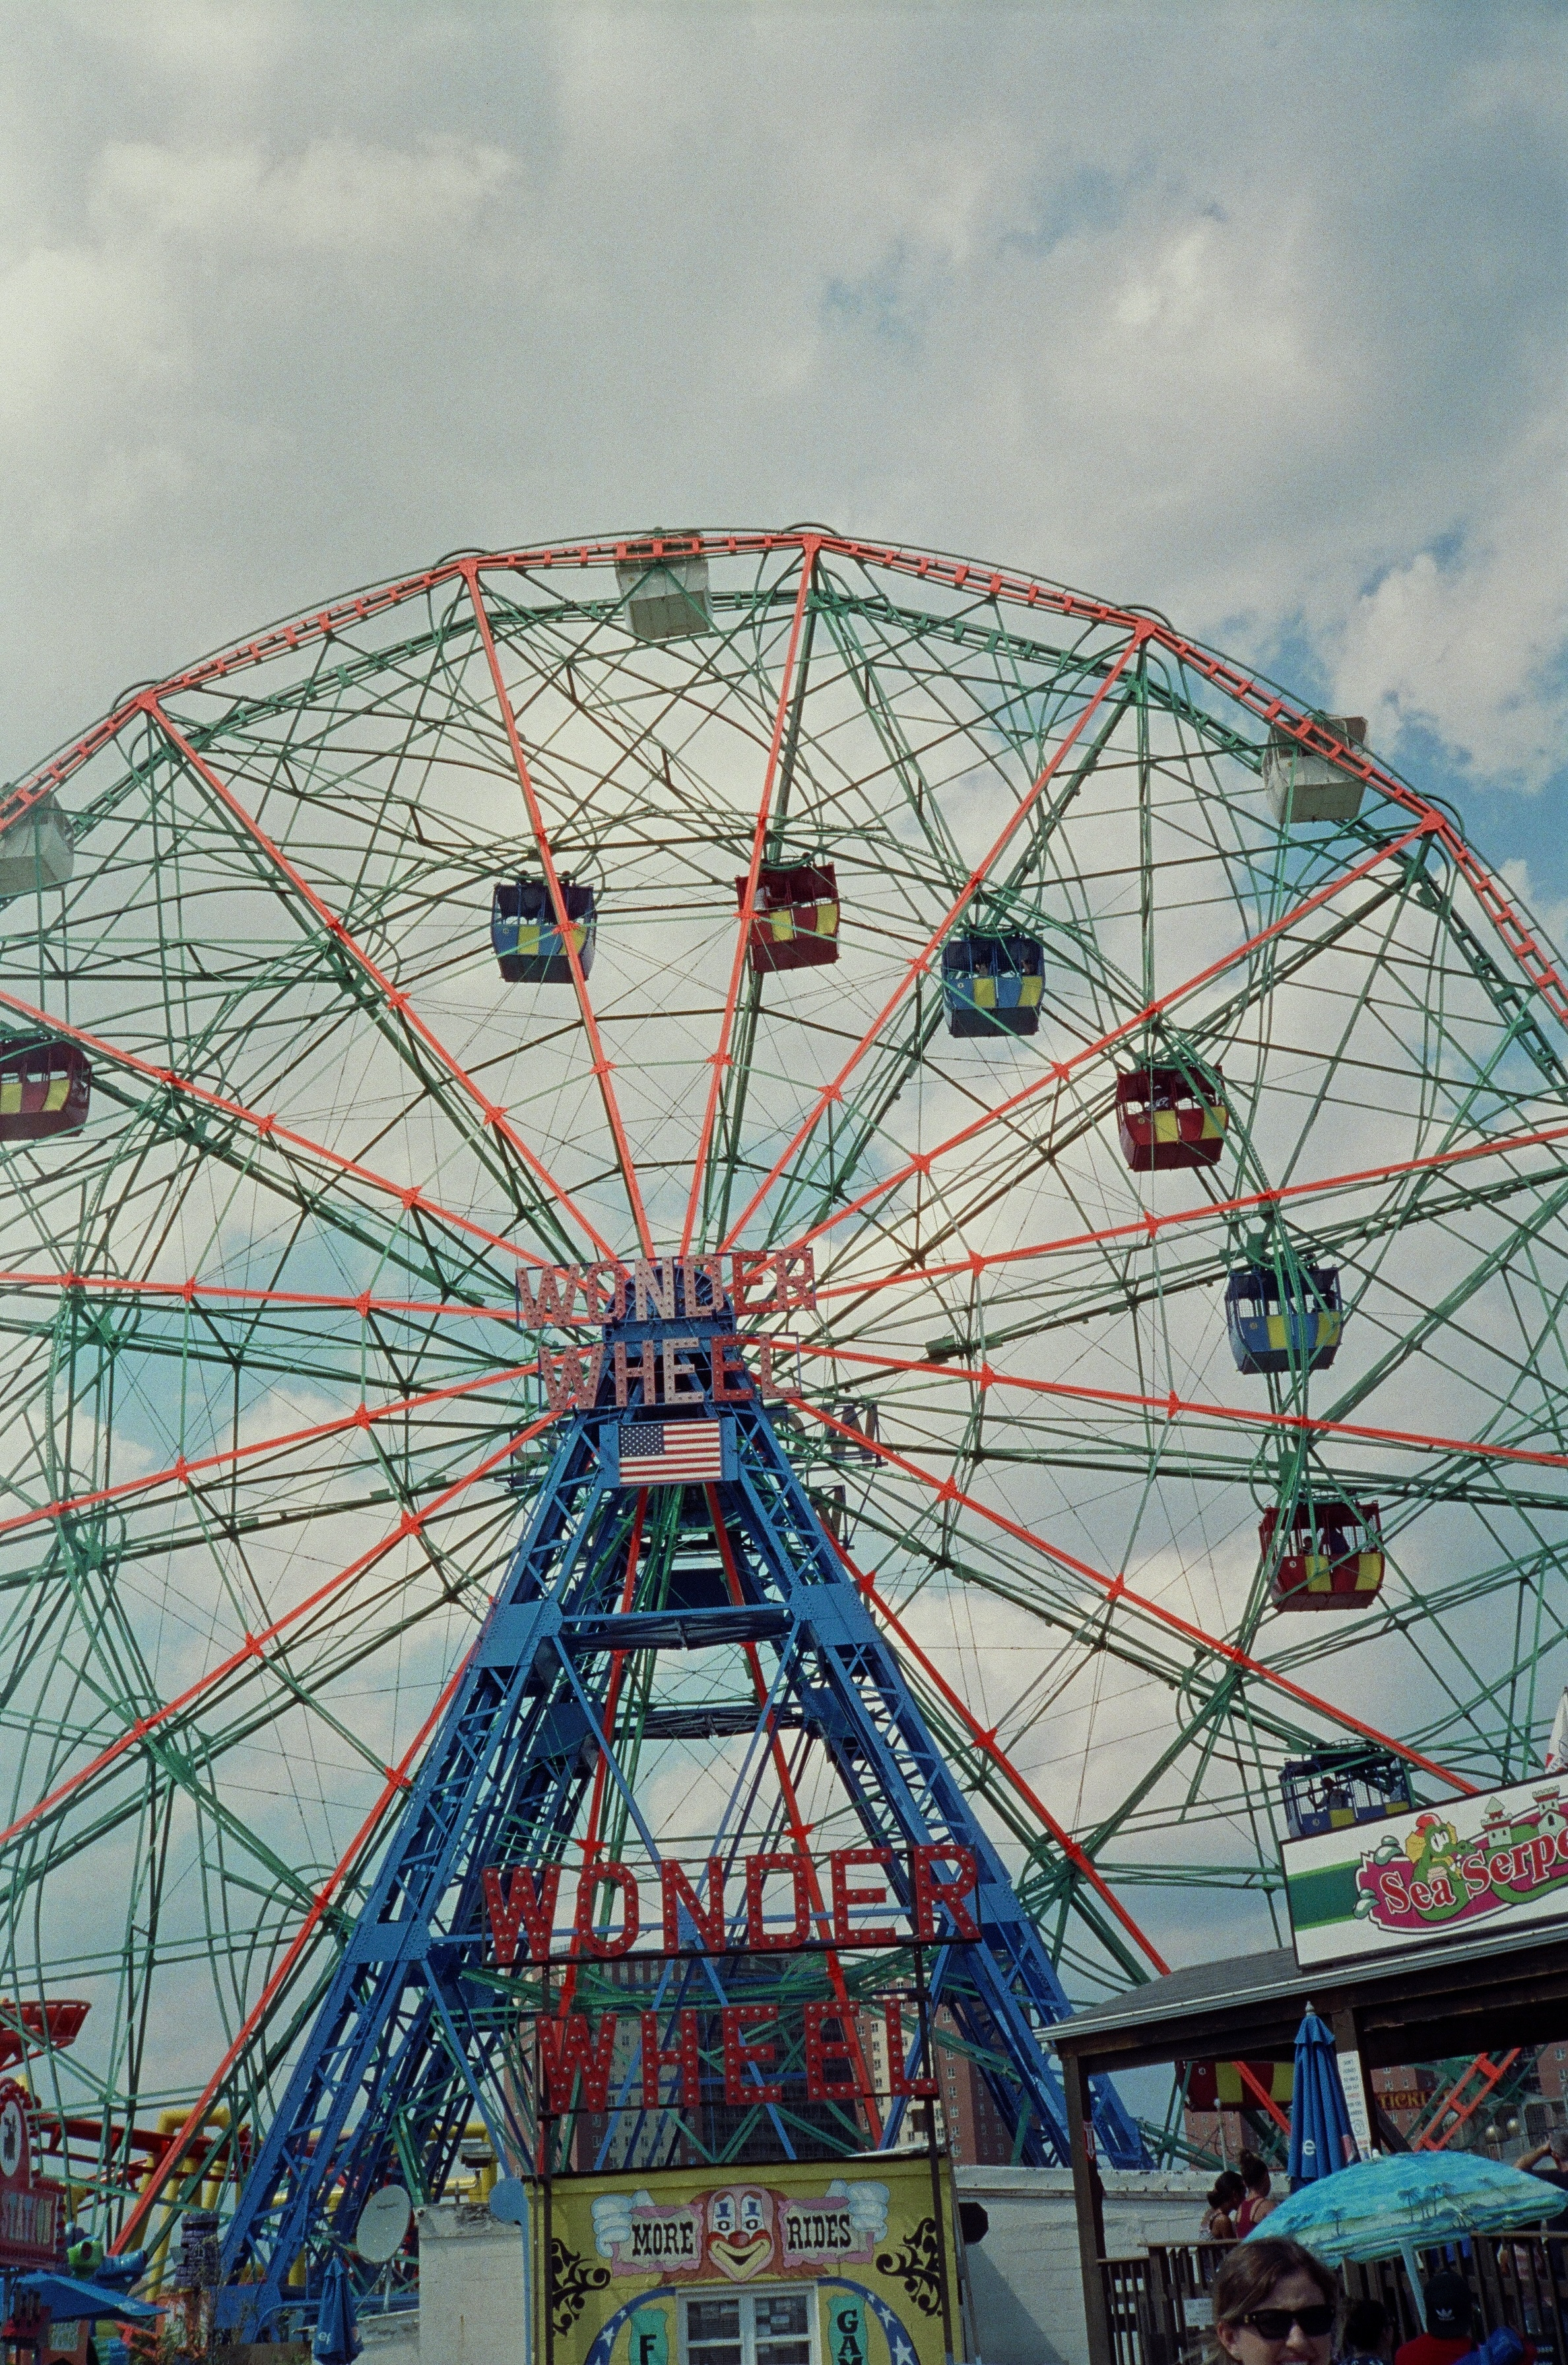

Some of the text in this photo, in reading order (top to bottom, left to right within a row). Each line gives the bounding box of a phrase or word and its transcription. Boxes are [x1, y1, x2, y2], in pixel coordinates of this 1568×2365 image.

[516, 1248, 817, 1329] WONDER
[539, 1332, 802, 1411] WHEEL
[482, 1845, 981, 1963] WONDER
[1379, 1871, 1456, 1914] Sea
[535, 1999, 938, 2112] WHEEL
[631, 2221, 694, 2256] MORE
[787, 2215, 851, 2248] RIDES
